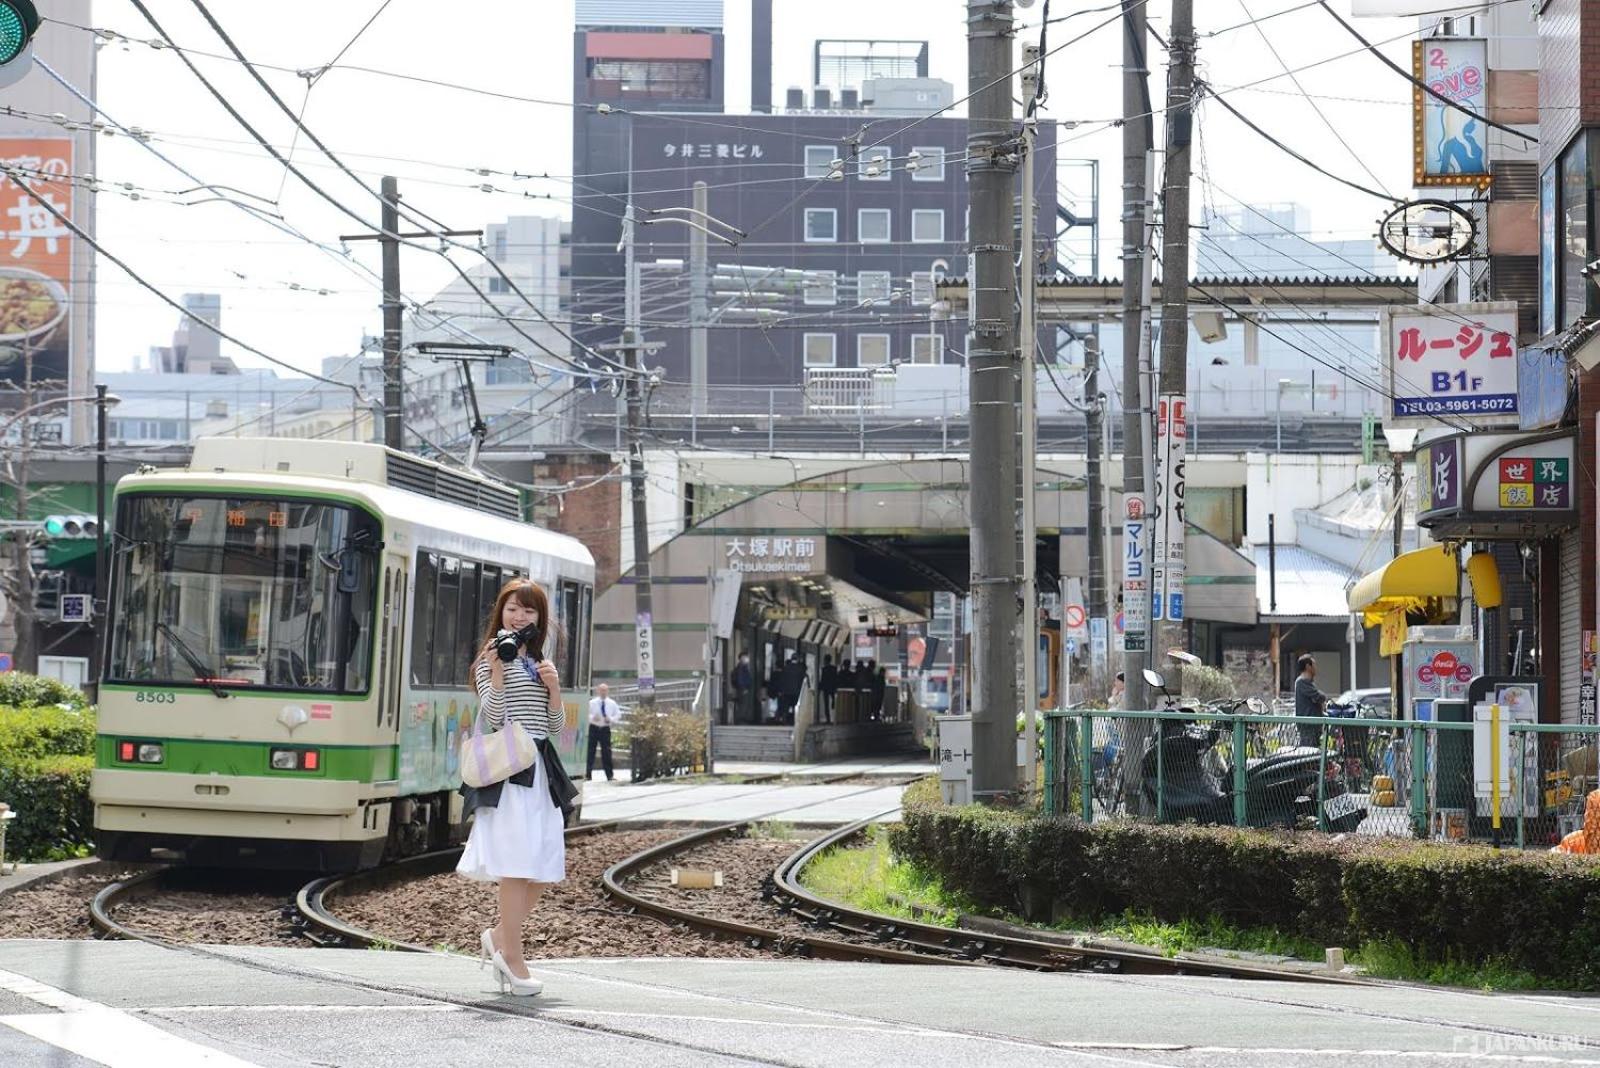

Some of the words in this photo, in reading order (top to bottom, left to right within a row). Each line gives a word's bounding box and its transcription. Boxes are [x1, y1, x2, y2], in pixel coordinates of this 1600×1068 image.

[1397, 322, 1513, 362] ルージュ
[1431, 369, 1484, 392] B1F
[726, 537, 815, 557] 大塚駅前
[1127, 523, 1143, 577] マルヨ
[136, 691, 176, 703] 8503
